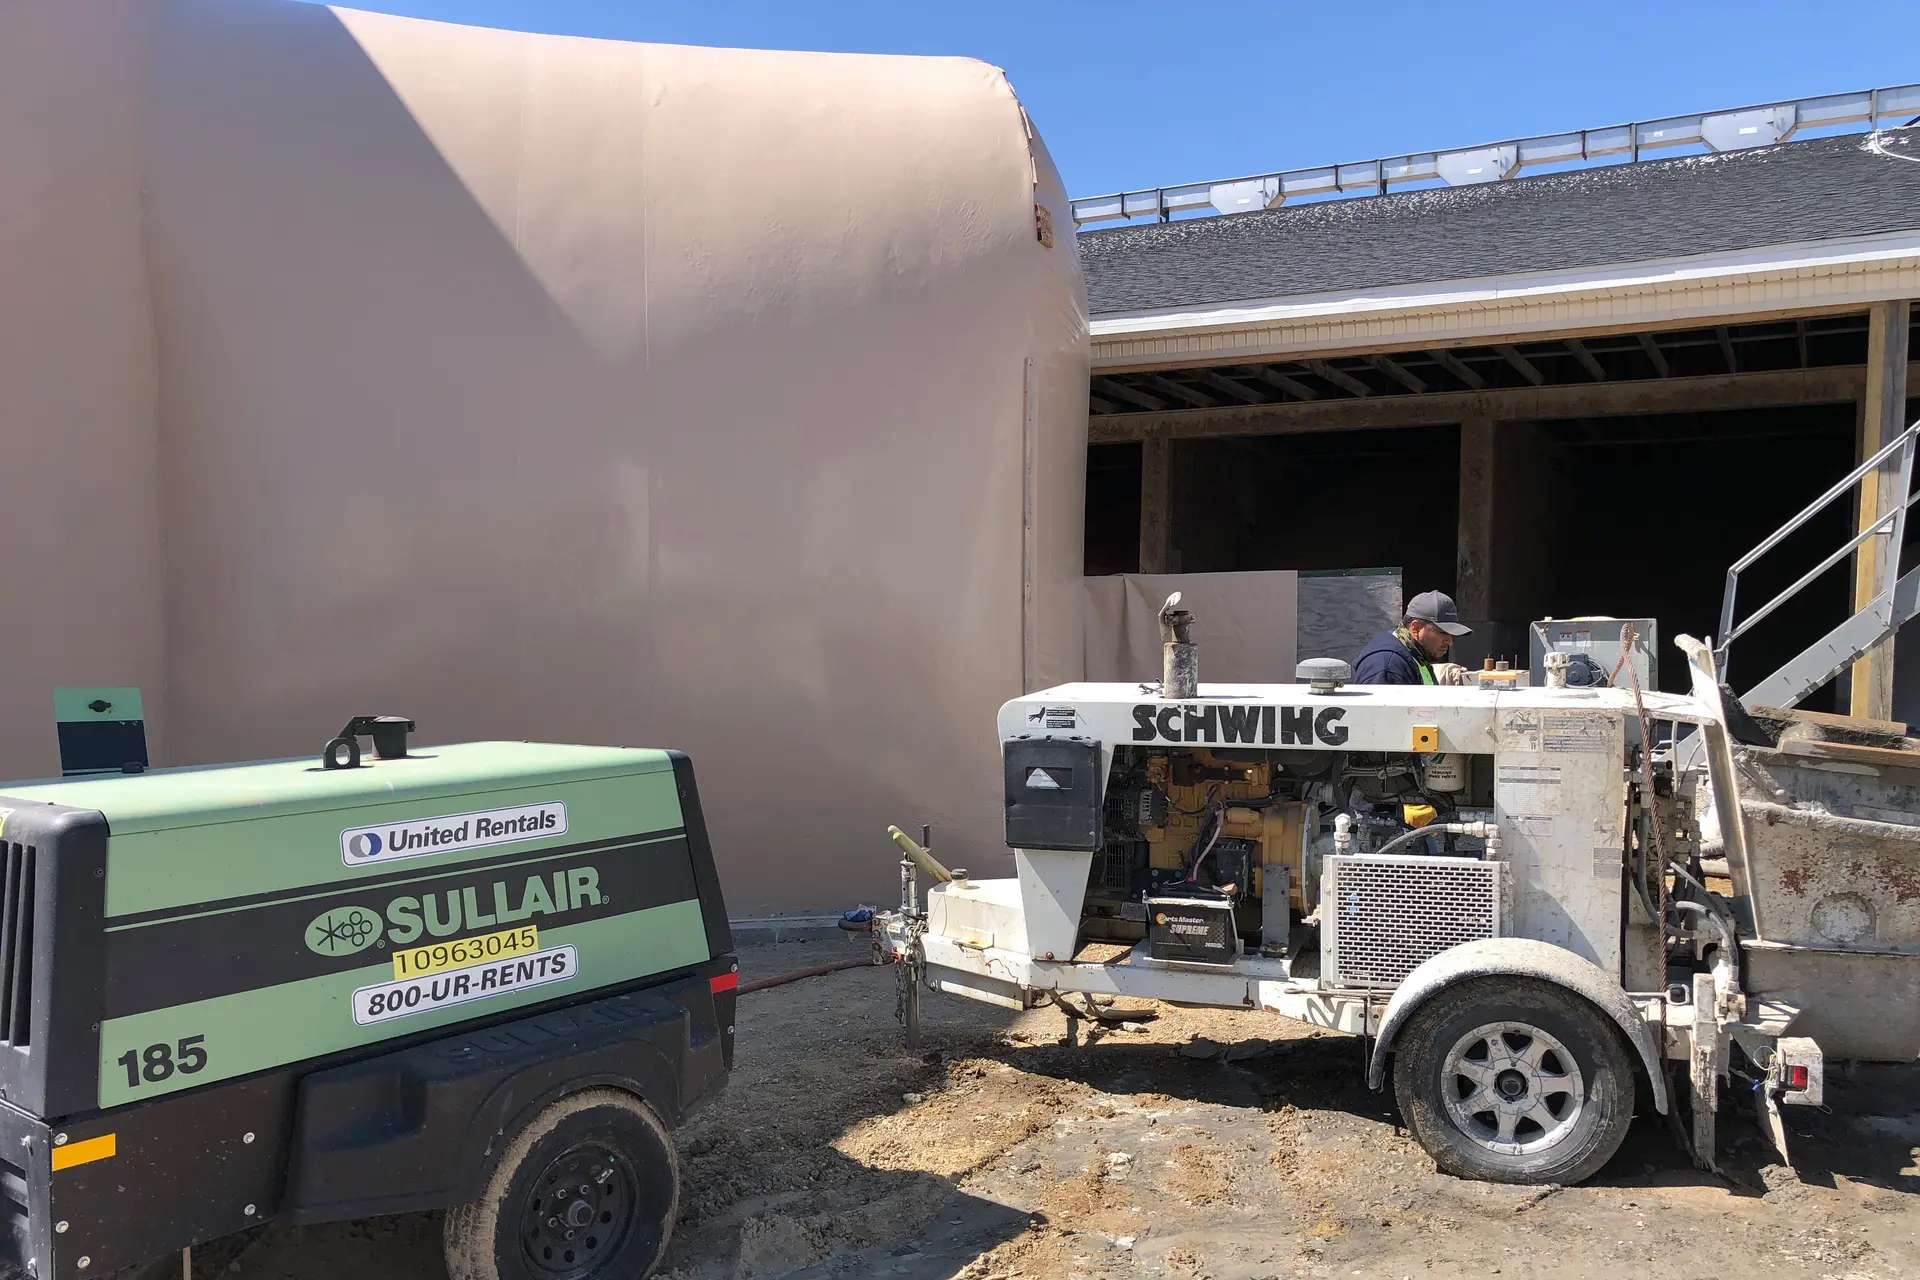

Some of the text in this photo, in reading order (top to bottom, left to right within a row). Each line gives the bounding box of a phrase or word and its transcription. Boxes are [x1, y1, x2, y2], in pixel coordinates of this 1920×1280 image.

[1132, 704, 1349, 746] SCHWING
[389, 809, 556, 852] United Rentals
[386, 866, 602, 944] SULLAIR
[1158, 915, 1178, 923] Parts
[396, 928, 535, 974] 10963045
[1169, 924, 1210, 936] SUPREME
[367, 952, 567, 1017] 800-UR-RENTS
[118, 1033, 208, 1088] 185
